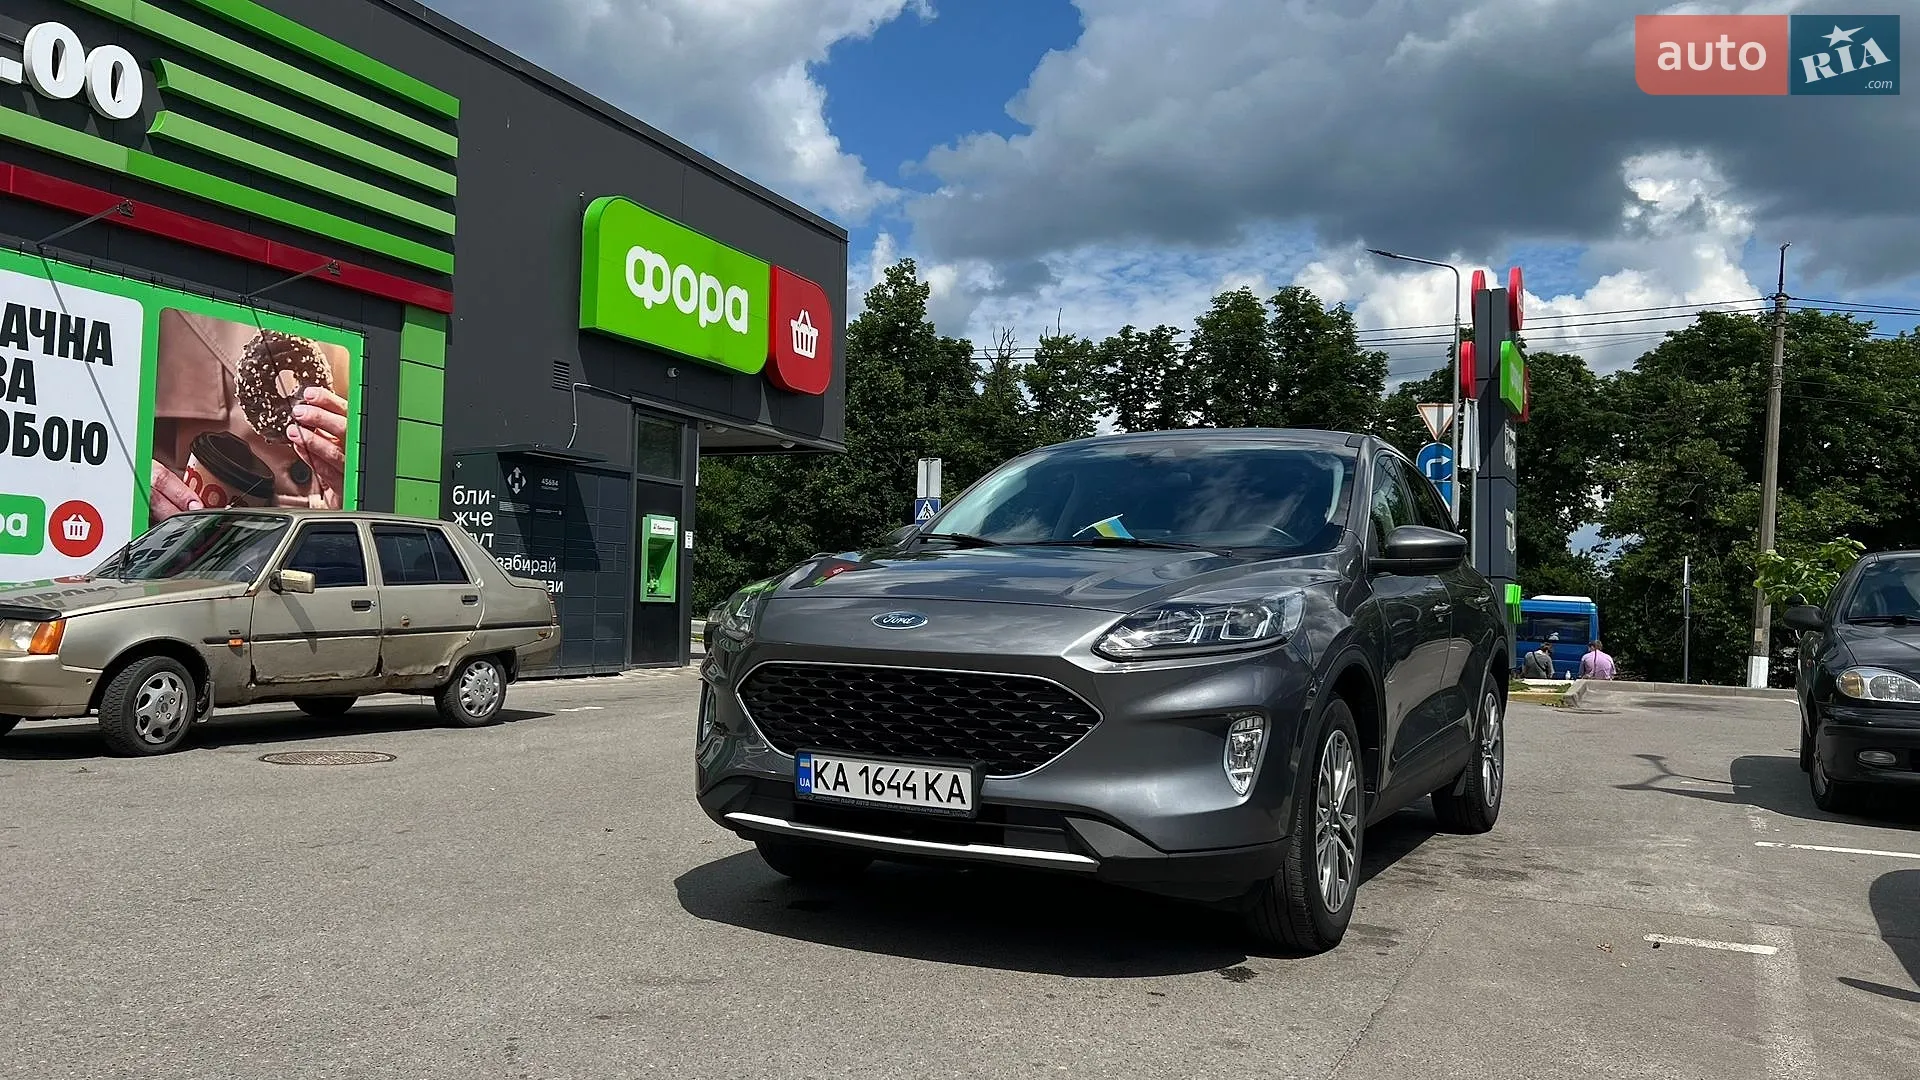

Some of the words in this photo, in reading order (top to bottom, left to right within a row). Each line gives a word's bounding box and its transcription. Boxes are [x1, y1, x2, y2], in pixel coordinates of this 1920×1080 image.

[625, 245, 748, 335] фора
[452, 485, 496, 505] бли-
[452, 511, 494, 527] жче
[496, 554, 557, 576] забирай
[799, 777, 811, 788] UA
[813, 760, 850, 792] KA
[858, 765, 917, 800] 1644
[924, 771, 967, 805] KA
